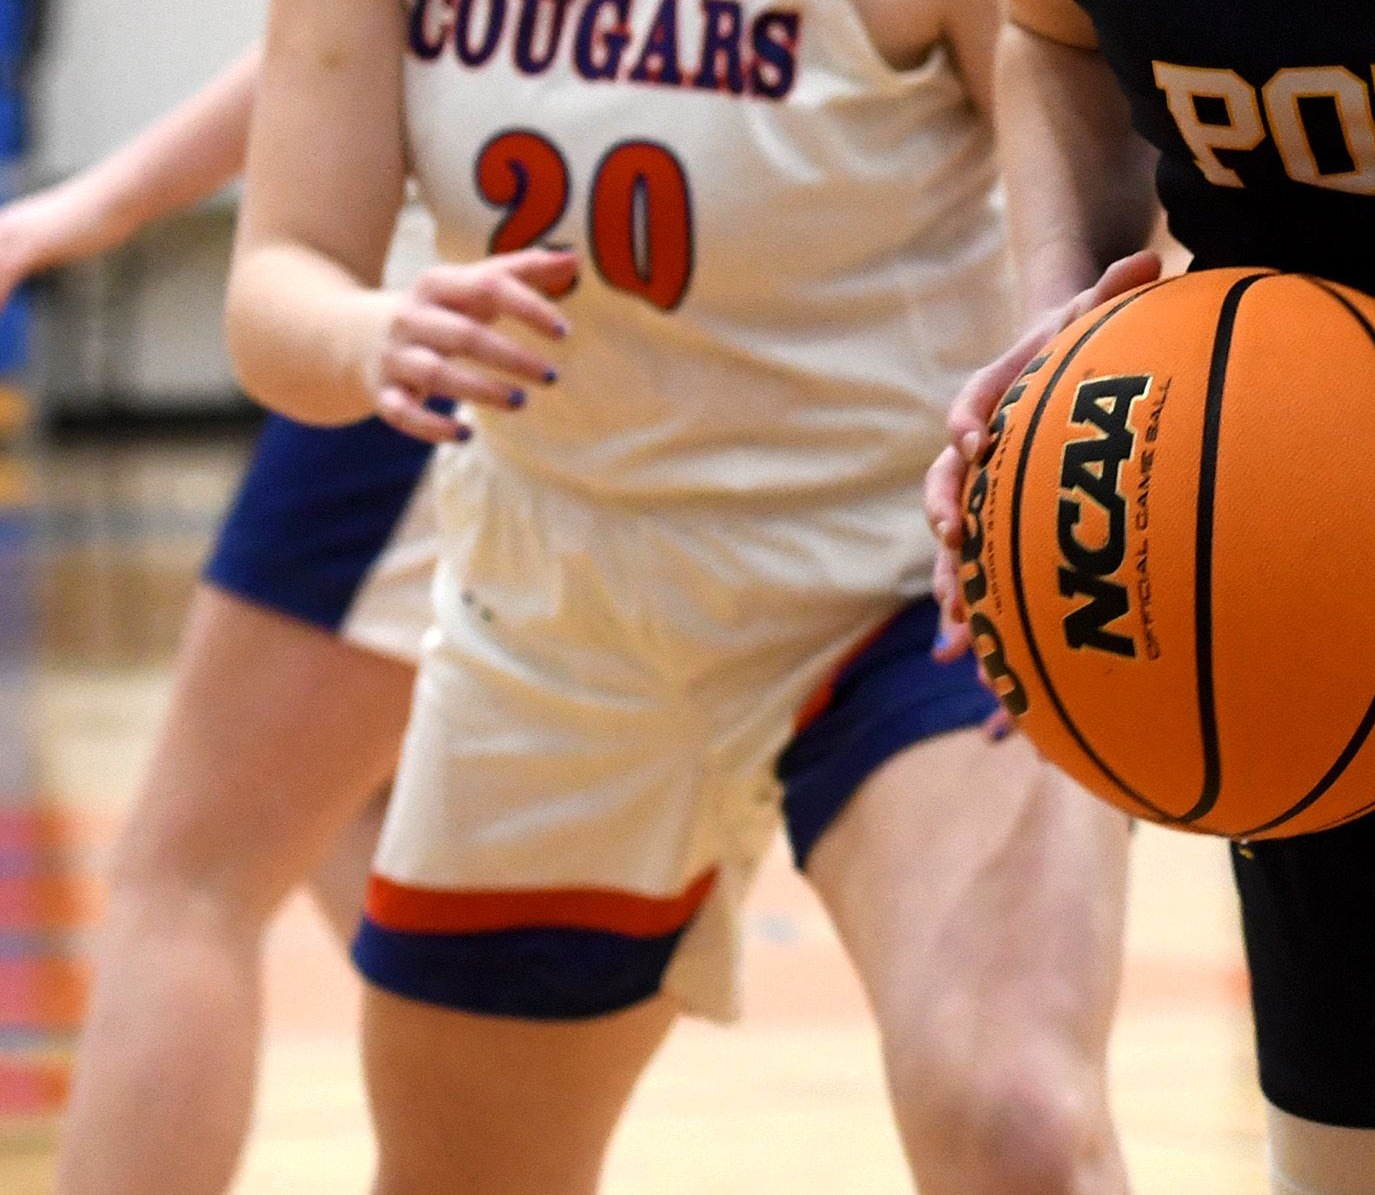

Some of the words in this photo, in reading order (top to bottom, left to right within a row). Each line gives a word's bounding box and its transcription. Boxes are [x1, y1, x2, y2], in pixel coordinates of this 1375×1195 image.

[474, 125, 696, 314] 20
[1144, 377, 1172, 443] BALL
[1057, 375, 1153, 658] NCAA
[1135, 449, 1155, 531] GAME
[1136, 539, 1161, 661] OFFICIAL
